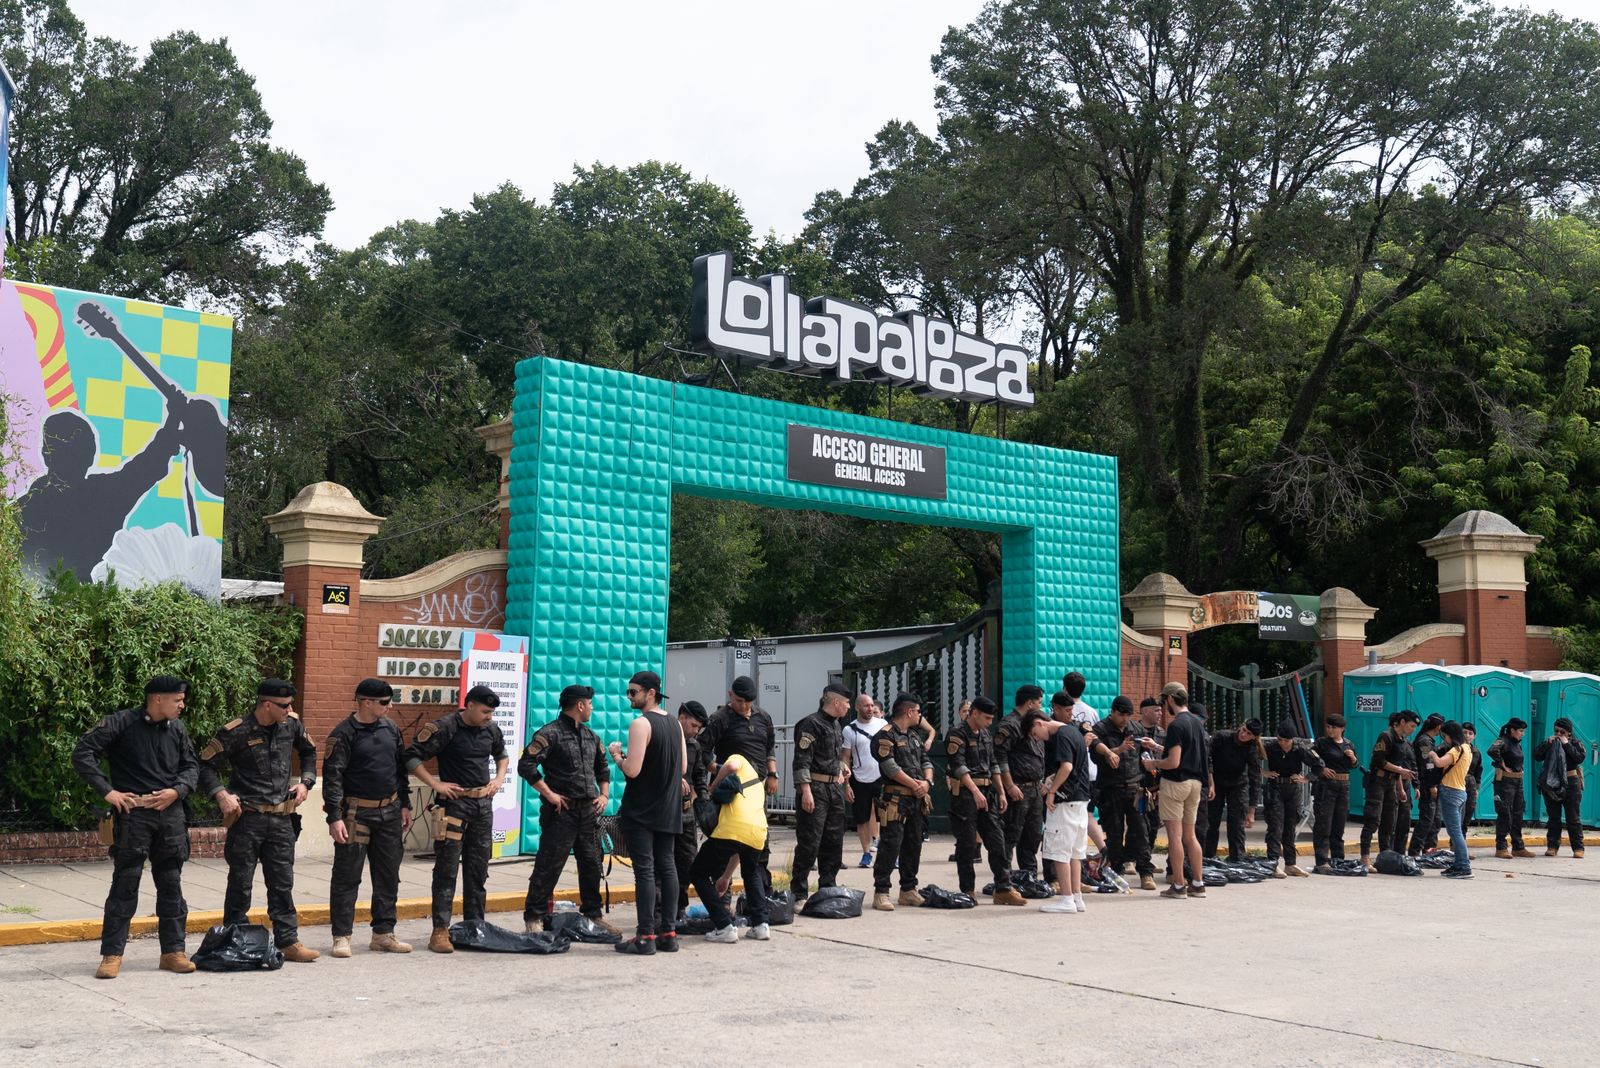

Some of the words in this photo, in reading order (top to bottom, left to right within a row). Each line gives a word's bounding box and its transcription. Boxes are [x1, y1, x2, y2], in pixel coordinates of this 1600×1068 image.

[812, 433, 866, 463] ACCESO
[870, 442, 926, 473] GENERAL
[835, 462, 873, 483] GENERAL
[874, 468, 906, 487] ACCESS
[327, 590, 346, 603] A&S
[1259, 624, 1287, 632] GRATUITA
[382, 628, 452, 648] JOCKEY
[411, 688, 442, 703] SAN
[1357, 695, 1383, 707] Basani
